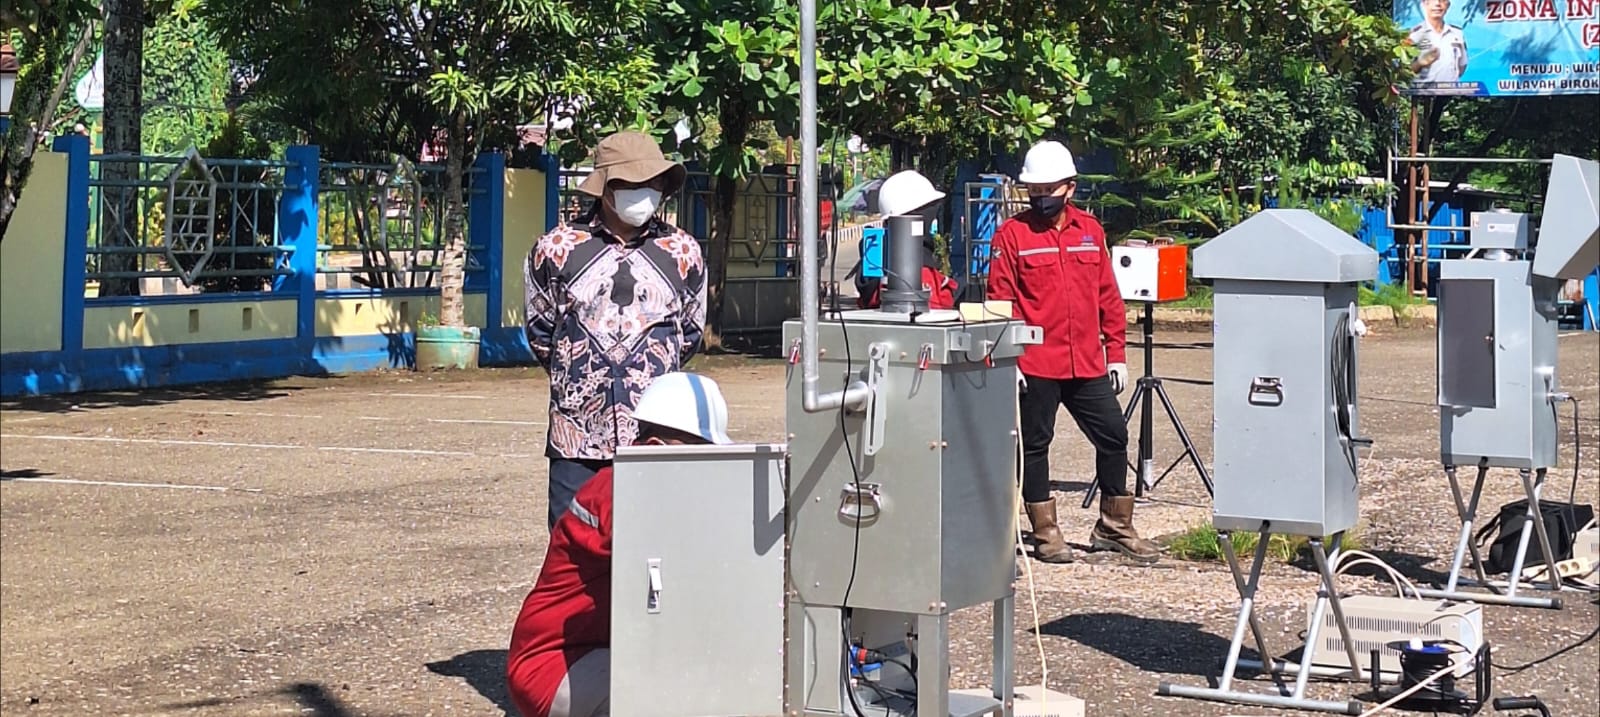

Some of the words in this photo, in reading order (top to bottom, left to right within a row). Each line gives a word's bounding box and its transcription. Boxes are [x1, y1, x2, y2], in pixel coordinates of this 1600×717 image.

[1486, 0, 1558, 21] ZONA
[1511, 63, 1562, 74] MENUJU
[1499, 79, 1556, 90] WILAYAH
[1561, 78, 1600, 89] BIROK
